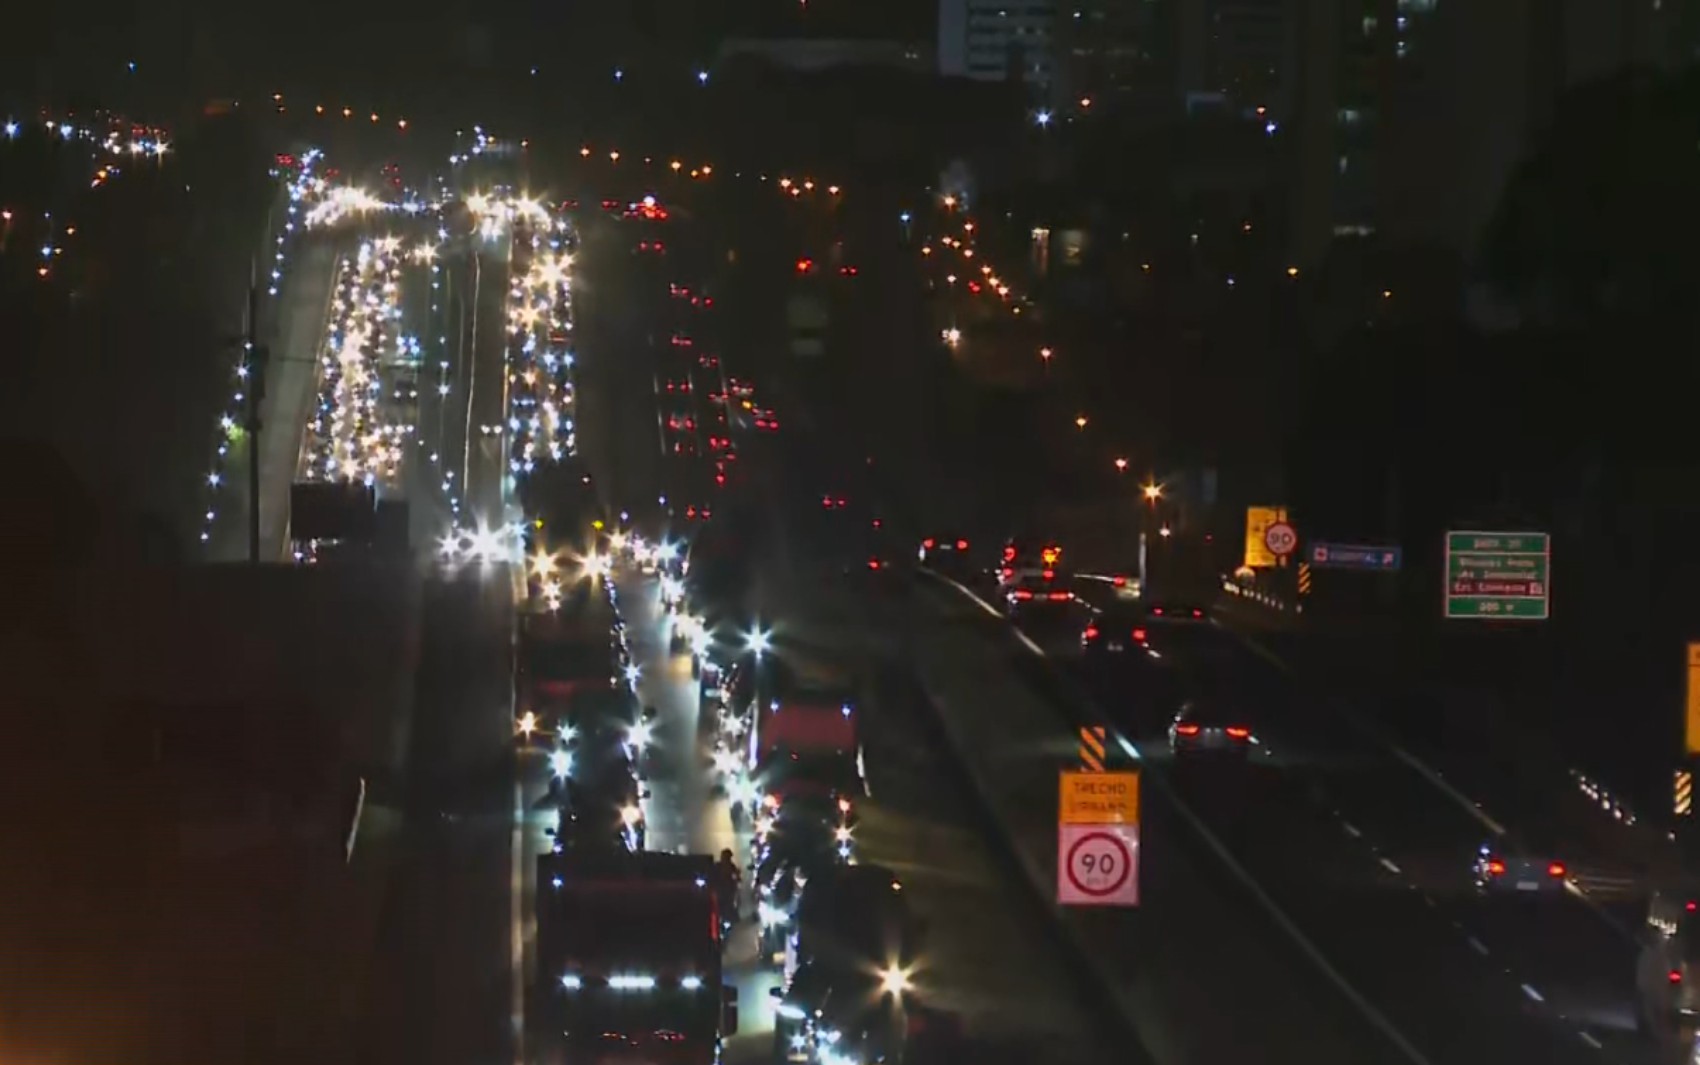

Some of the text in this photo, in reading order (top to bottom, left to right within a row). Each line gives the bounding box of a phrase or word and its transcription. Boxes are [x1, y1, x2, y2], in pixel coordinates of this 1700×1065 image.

[1270, 533, 1292, 545] 90
[1073, 781, 1127, 795] TRECHO
[1081, 853, 1115, 875] 90
